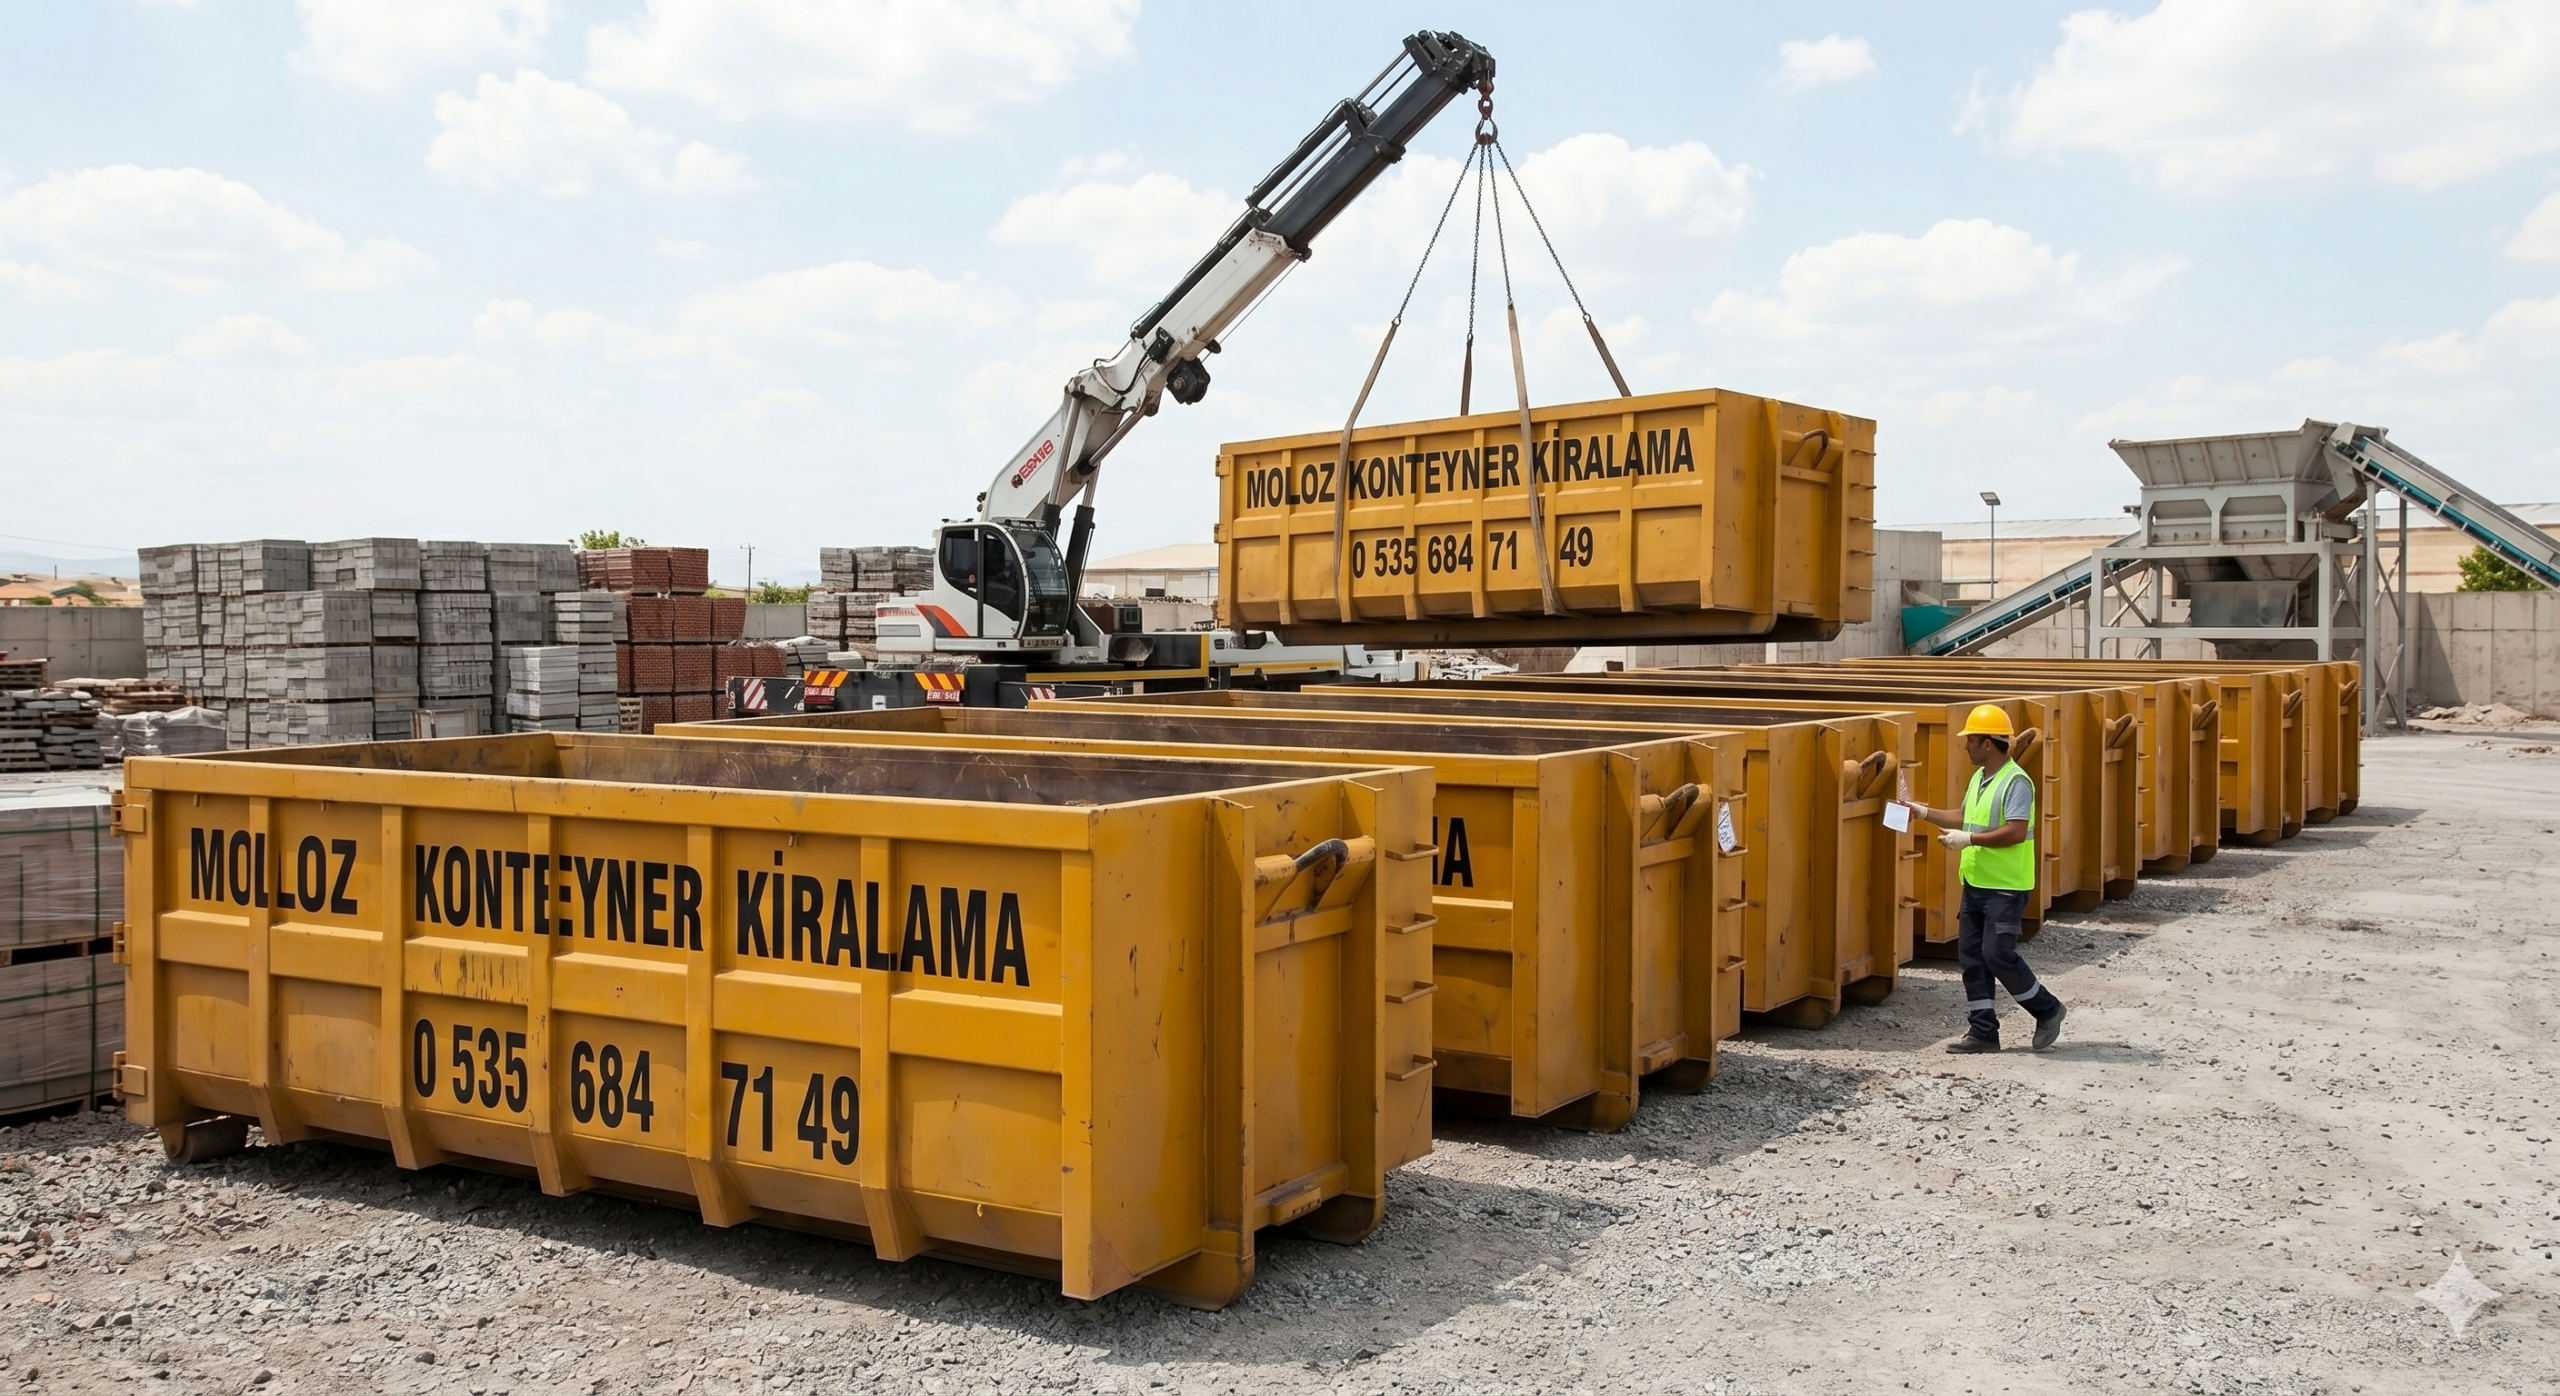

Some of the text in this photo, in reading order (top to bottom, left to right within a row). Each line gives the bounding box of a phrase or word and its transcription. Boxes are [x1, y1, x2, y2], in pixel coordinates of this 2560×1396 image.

[1246, 427, 1695, 509] MOLOZ KONTEYNER KİRALAMA
[1352, 526, 1594, 579] 0 535 684 71 49
[1432, 815, 1474, 889] A
[415, 844, 705, 952] KONTEYNER
[737, 850, 1031, 988] KİRALAMA
[413, 1018, 861, 1166] 0 535 684 71 49
